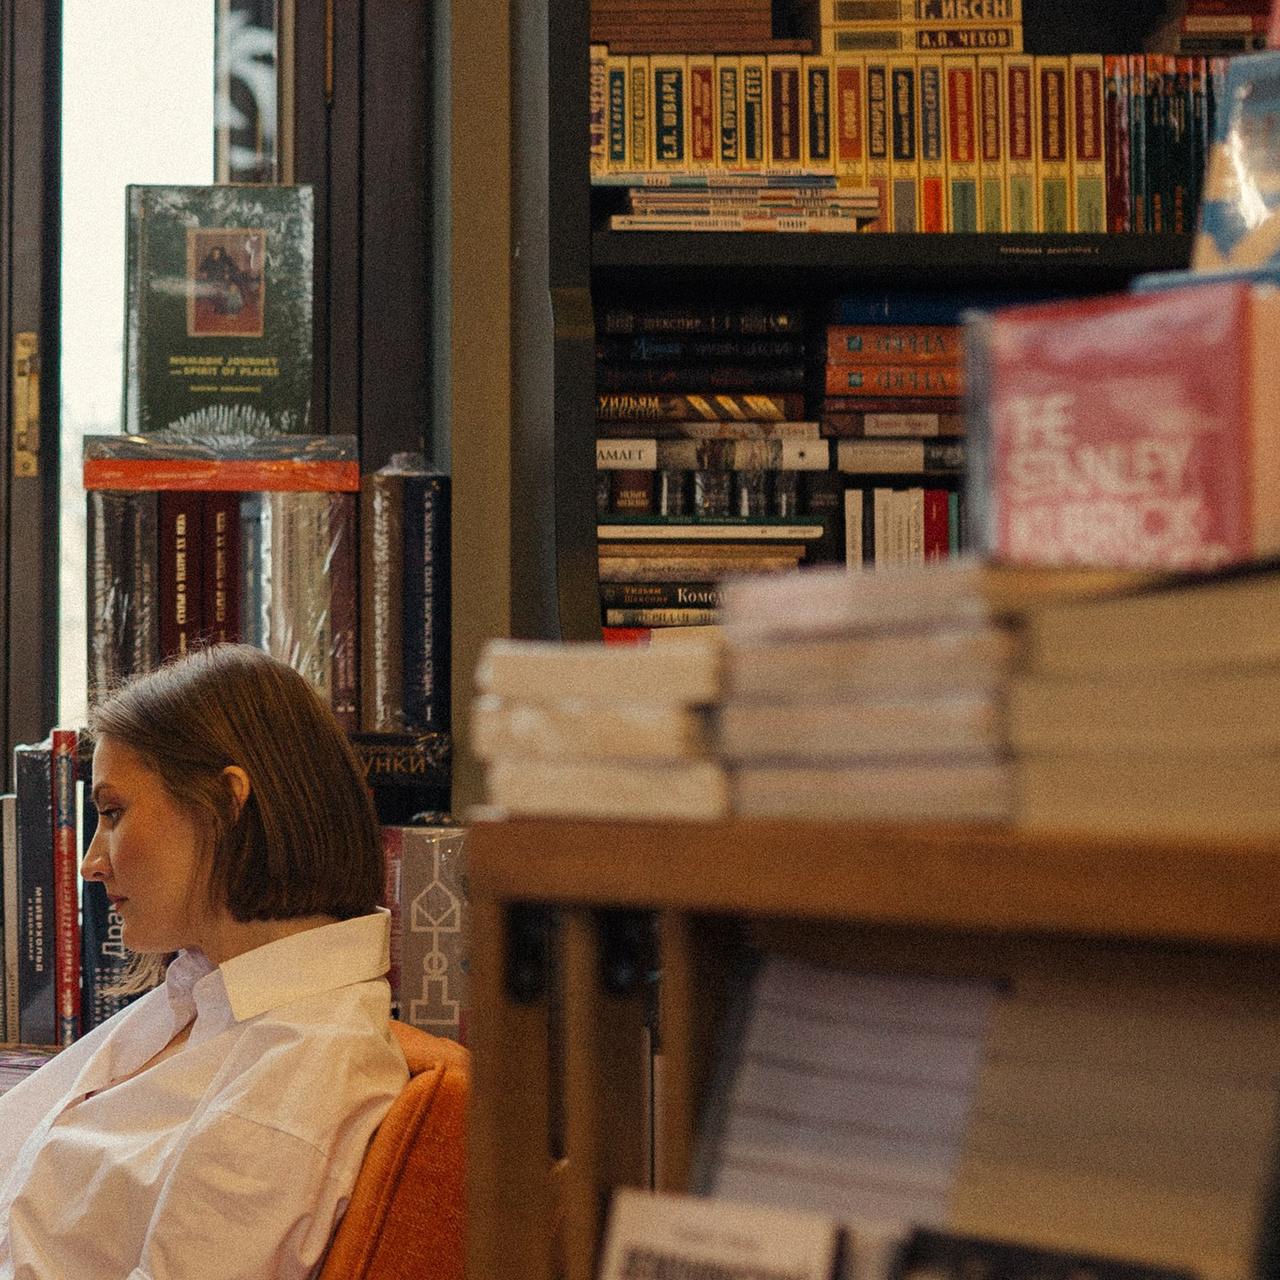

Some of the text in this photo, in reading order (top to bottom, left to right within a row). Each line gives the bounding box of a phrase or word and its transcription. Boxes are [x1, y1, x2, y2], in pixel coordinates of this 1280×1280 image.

[941, 0, 1007, 19] ИБСЕН
[921, 31, 1007, 46] А.П. ЧЕХОВ
[589, 65, 605, 113] ЧЕХОВ
[723, 72, 736, 129] ПУШКИН
[746, 70, 761, 102] ГЕТЕ
[662, 73, 678, 158] Е.Л. ШВАРЦ
[221, 366, 236, 376] OF
[597, 448, 645, 461] АМЛЕТ
[359, 756, 426, 778] УНКИ
[35, 886, 44, 972] МЕЙЕРХОЛЬД
[101, 903, 128, 959] Дра
